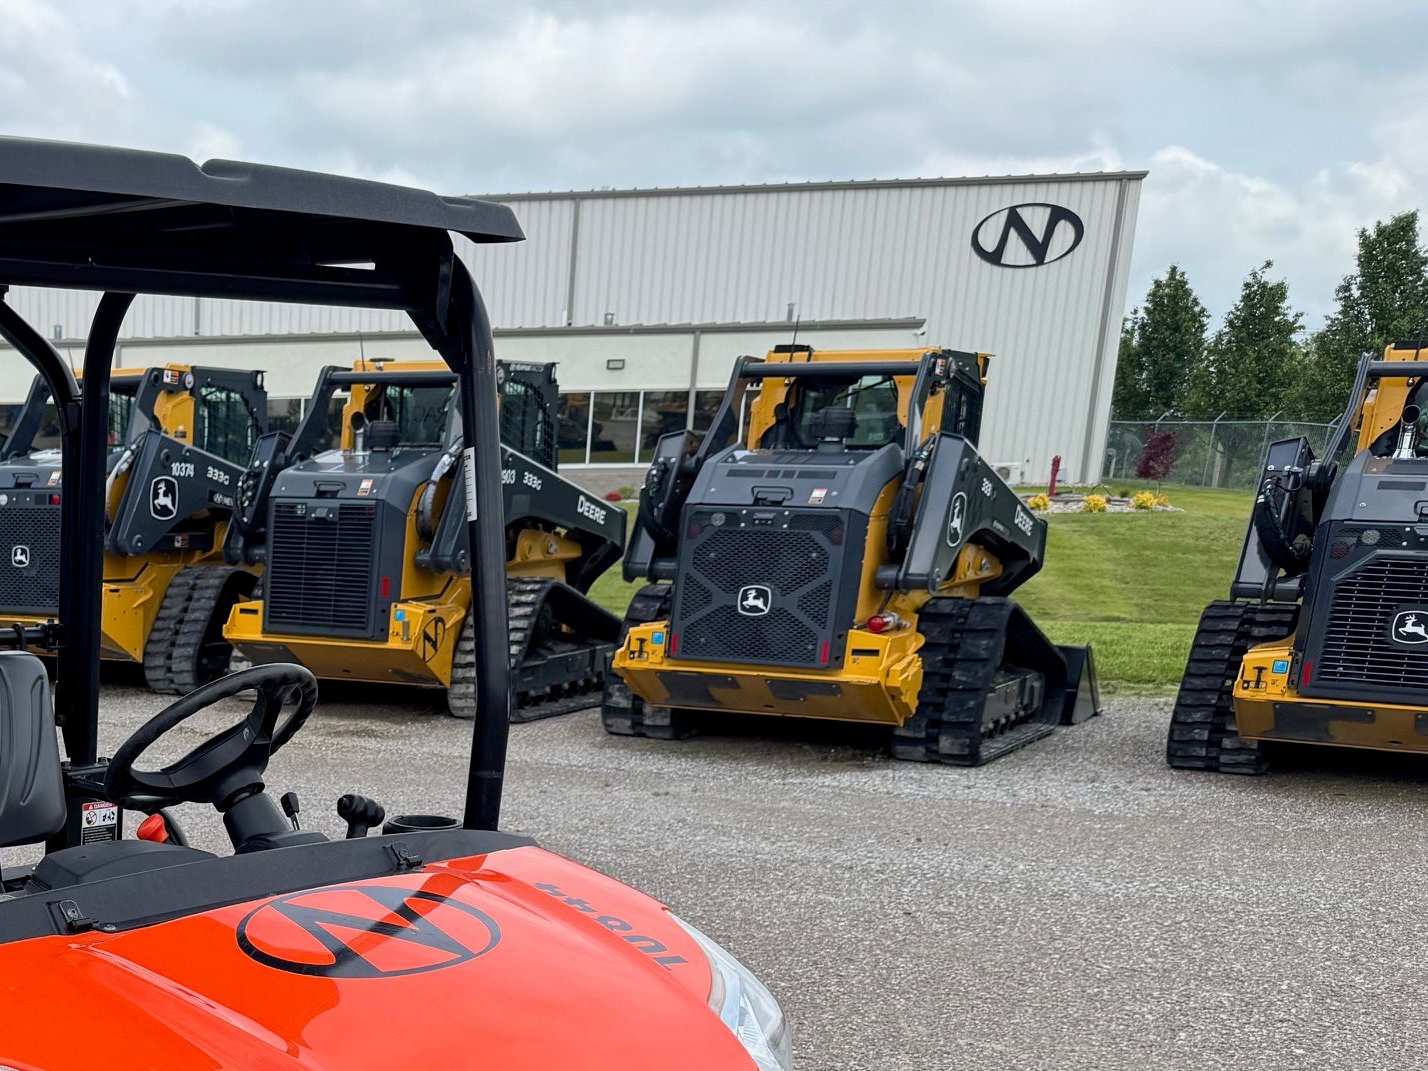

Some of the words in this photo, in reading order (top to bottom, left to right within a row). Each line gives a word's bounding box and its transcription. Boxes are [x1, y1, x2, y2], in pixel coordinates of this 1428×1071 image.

[971, 202, 1085, 269] N
[171, 461, 195, 478] 10374
[577, 494, 607, 525] DEERE
[1013, 503, 1033, 537] DEERE
